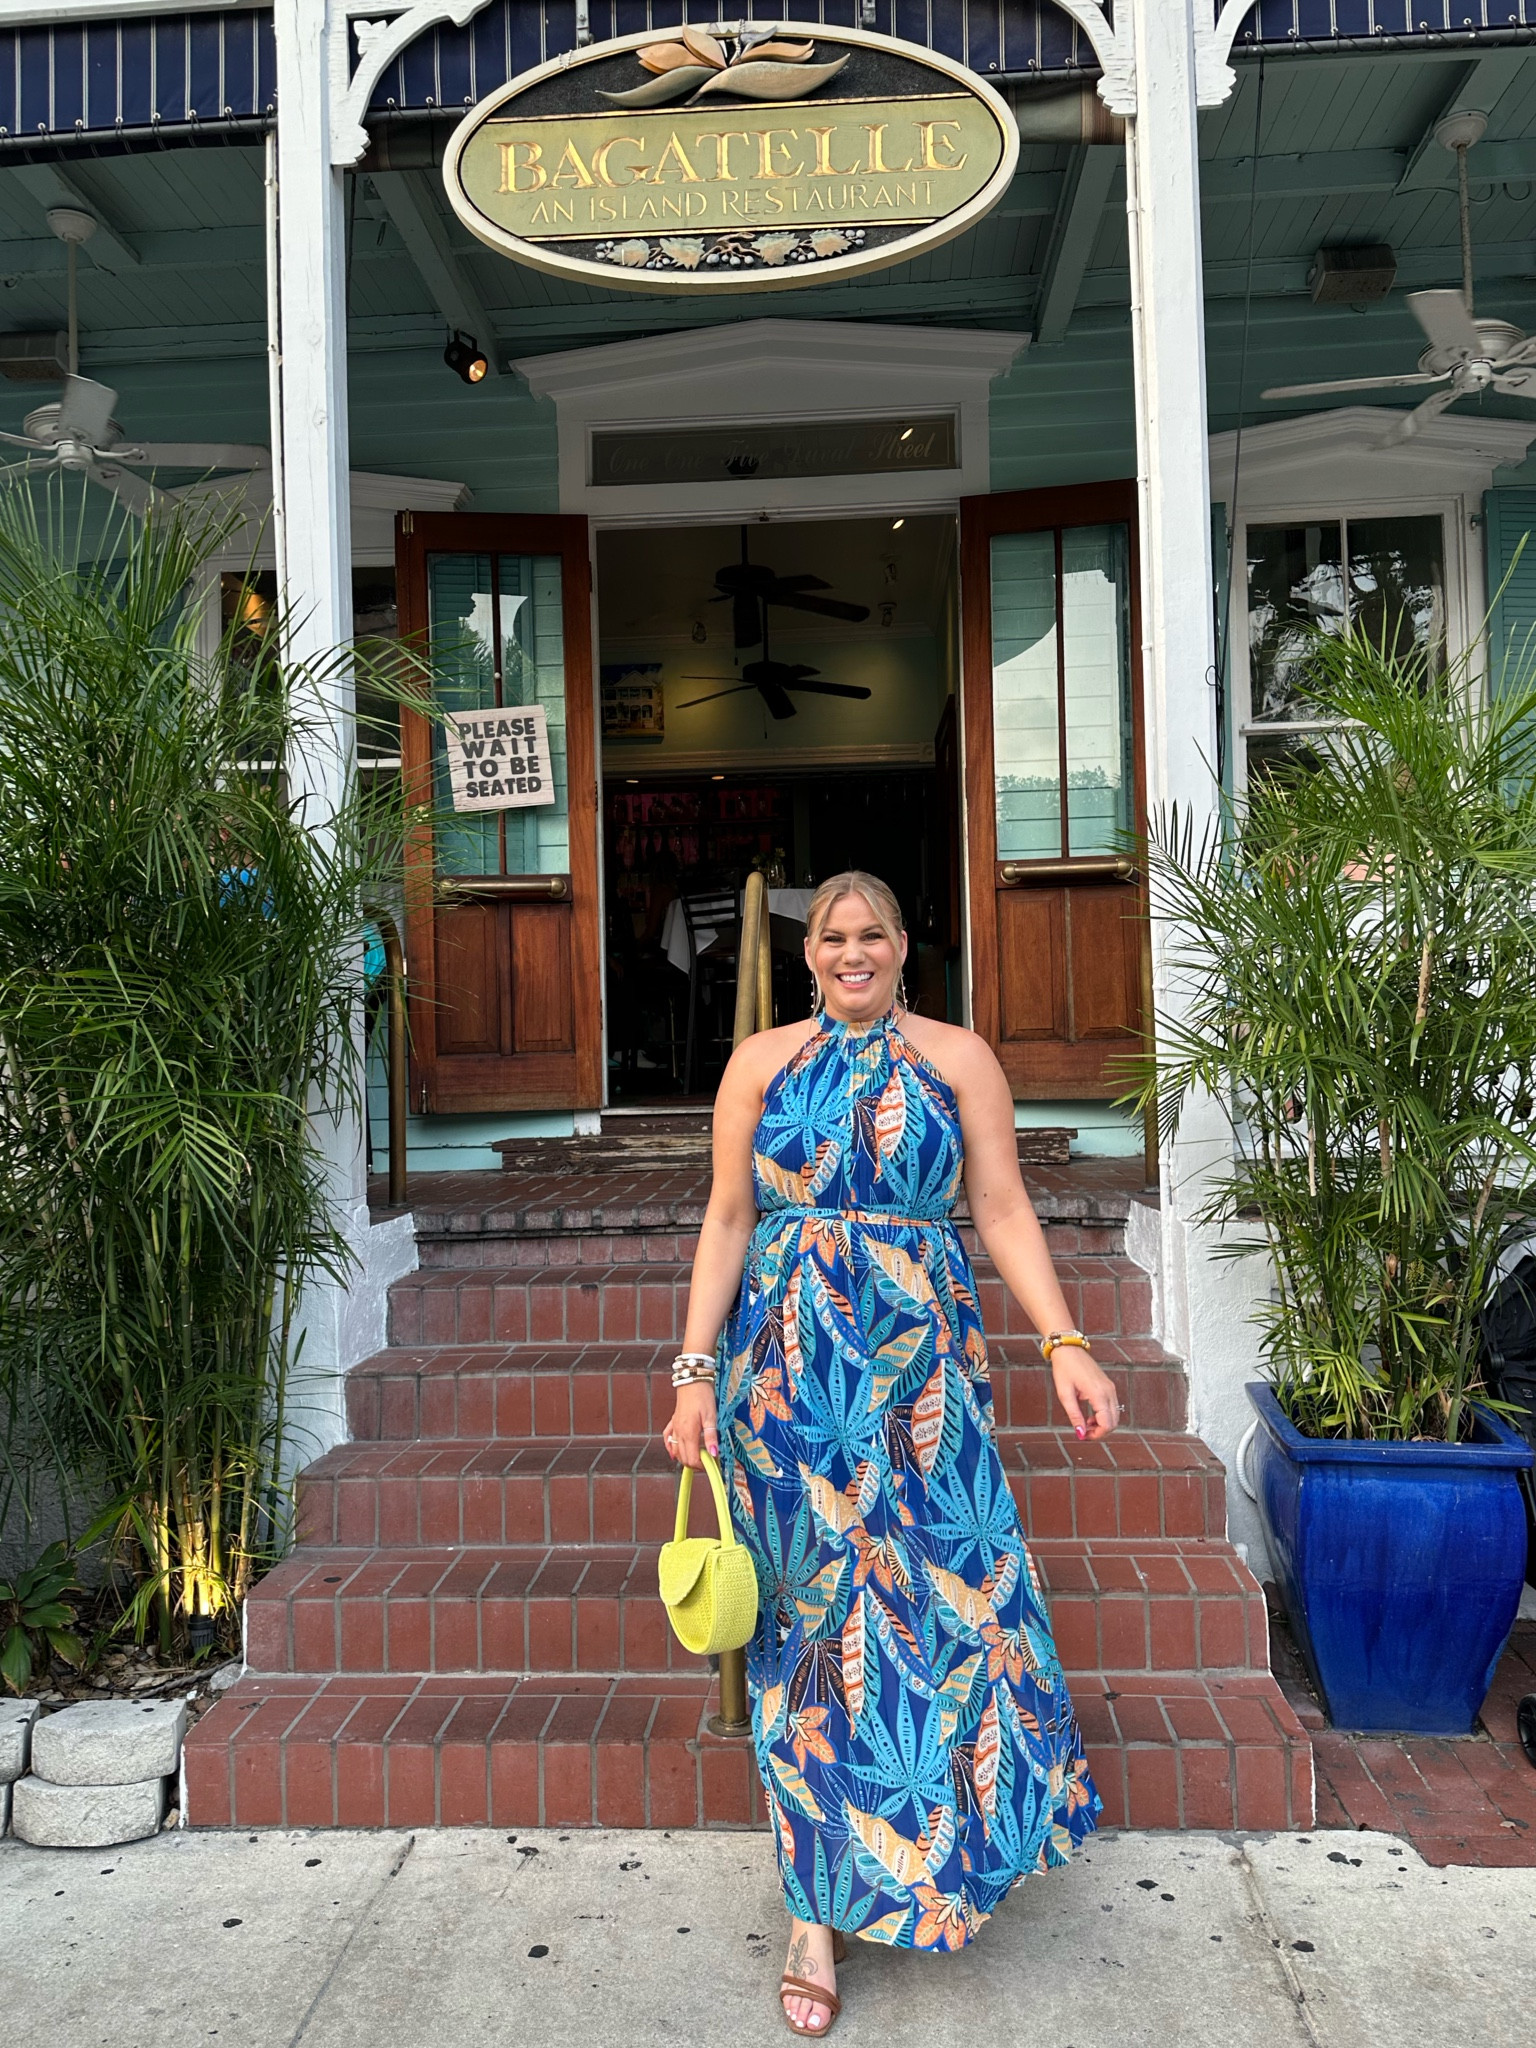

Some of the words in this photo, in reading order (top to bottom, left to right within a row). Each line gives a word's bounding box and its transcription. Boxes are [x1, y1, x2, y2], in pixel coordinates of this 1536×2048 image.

[494, 120, 968, 194] BAGATELLE
[530, 198, 574, 224] AN
[590, 191, 707, 222] ISLAND
[721, 179, 936, 223] RESTAURANT
[868, 431, 937, 461] Street
[460, 717, 536, 740] PLEASE
[461, 736, 537, 759] WAIT
[463, 759, 499, 779] TO
[510, 755, 540, 775] BE
[465, 776, 542, 798] SEATED
